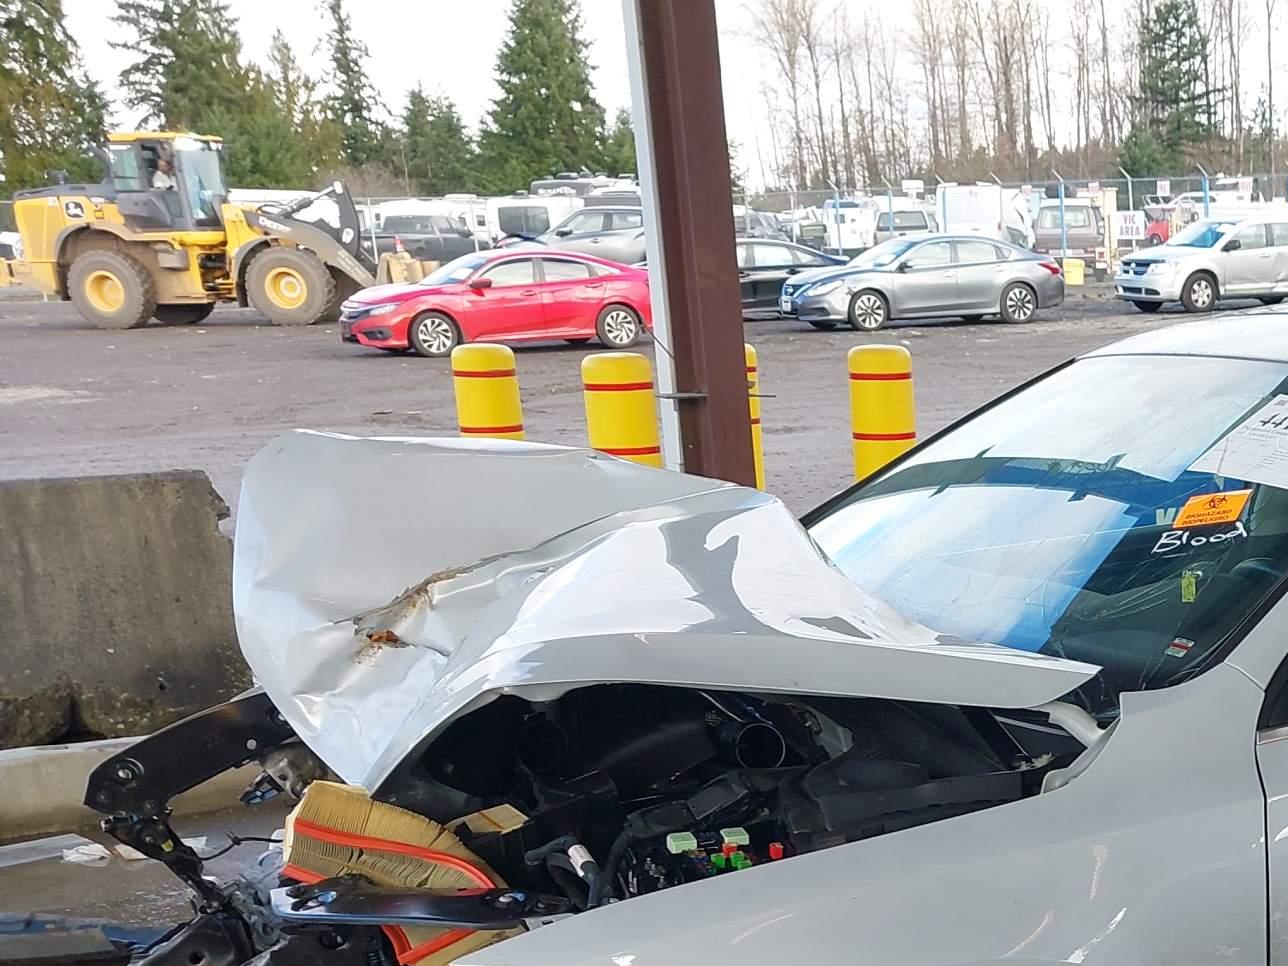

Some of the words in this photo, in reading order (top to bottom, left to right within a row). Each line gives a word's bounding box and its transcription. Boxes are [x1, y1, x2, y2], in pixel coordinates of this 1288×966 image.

[1123, 214, 1136, 225] VIC
[1119, 225, 1141, 236] AREA
[1151, 521, 1248, 554] Blood
